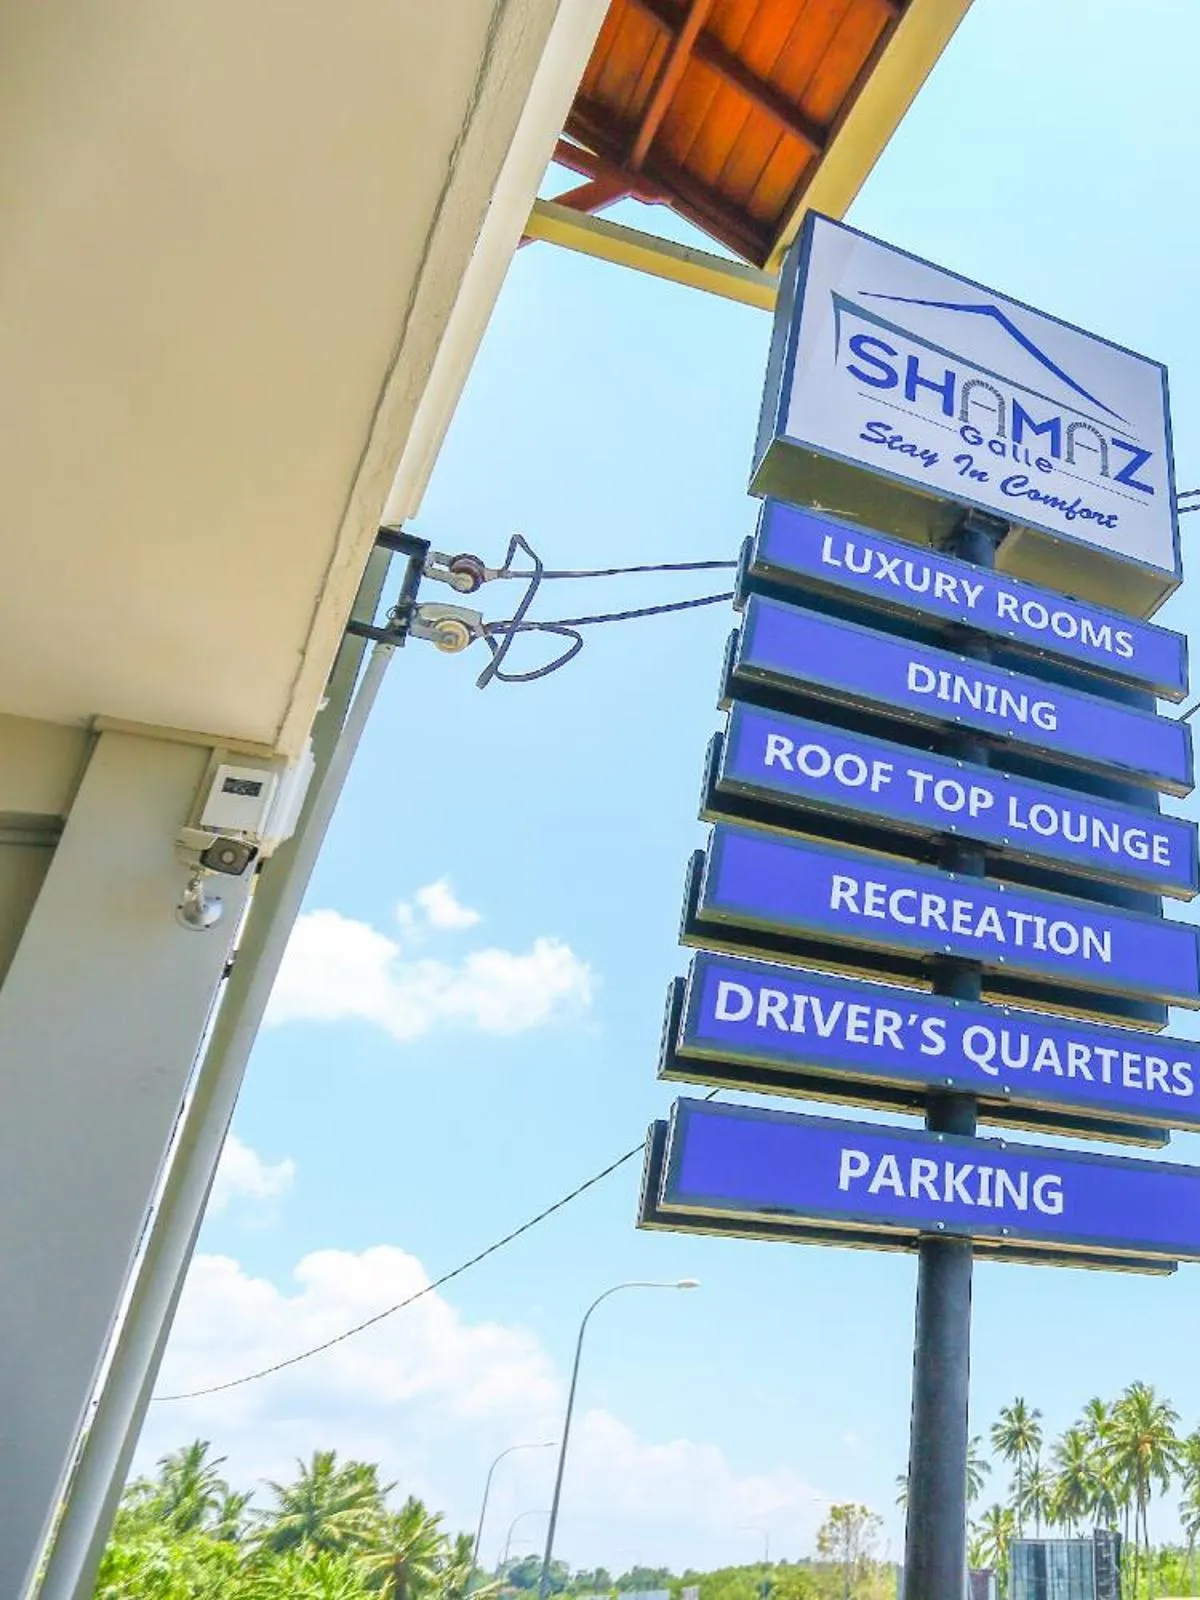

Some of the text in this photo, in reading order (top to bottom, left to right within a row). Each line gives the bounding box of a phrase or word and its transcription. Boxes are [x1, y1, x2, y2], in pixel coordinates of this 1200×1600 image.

[846, 333, 1155, 496] SHAMAZ
[958, 425, 1055, 475] Galle
[859, 420, 1119, 530] Stay In Comfort
[821, 534, 1135, 659] LUXURY ROOMS
[906, 661, 1058, 731] DINING
[763, 733, 1171, 867] ROOF TOP LOUNGE
[829, 874, 1112, 963] RECREATION
[714, 980, 1194, 1098] DRIVER'S QUARTERS
[838, 1148, 1064, 1216] PARKING
